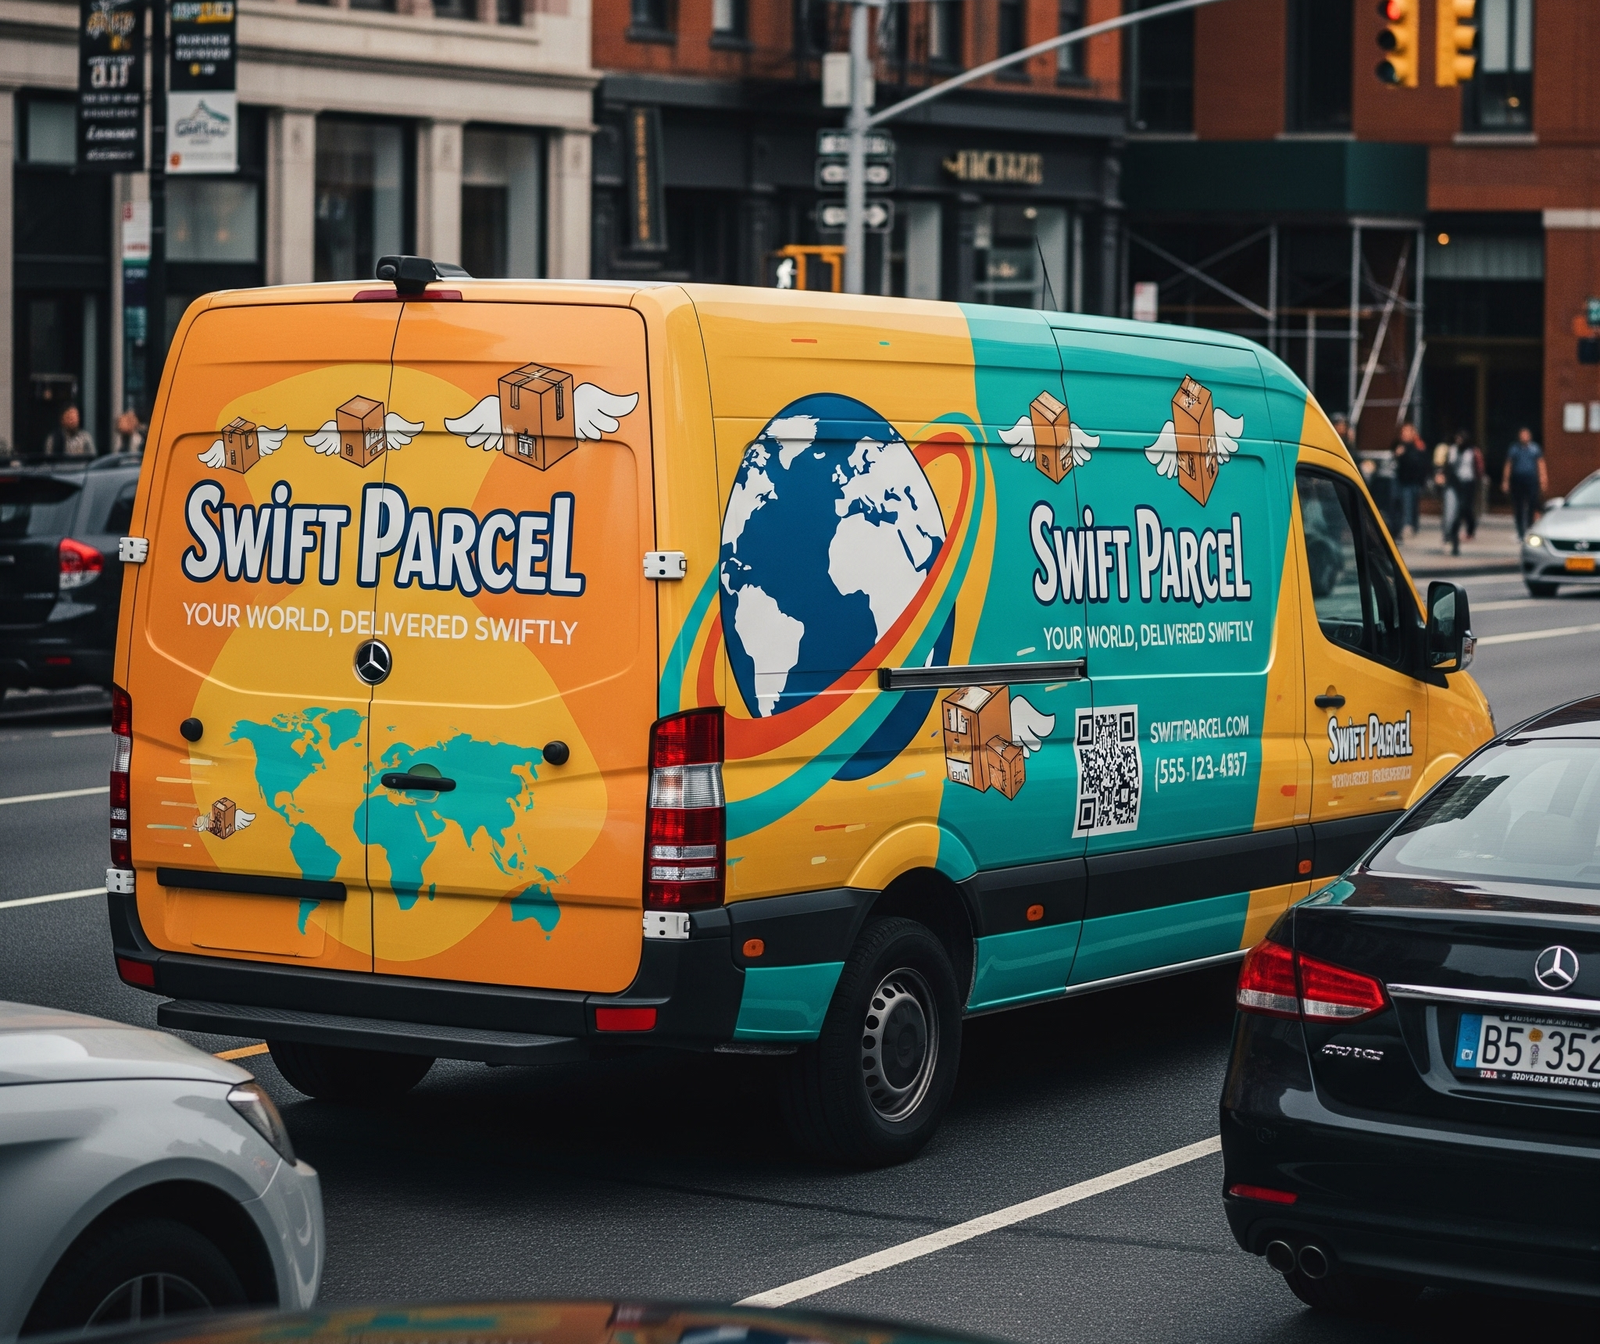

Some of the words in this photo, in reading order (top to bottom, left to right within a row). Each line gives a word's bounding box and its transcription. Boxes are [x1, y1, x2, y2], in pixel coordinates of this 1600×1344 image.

[182, 602, 241, 628] YOUR
[246, 604, 333, 638] WORLD,
[340, 609, 468, 640] DELIVERED
[475, 616, 579, 646] SWIFTLY
[1043, 625, 1083, 650] YOUR
[1086, 624, 1138, 652] WORLD,
[1141, 622, 1206, 647] DELIVERED
[1208, 619, 1254, 644] SWIFTLY
[1482, 1024, 1526, 1067] B5
